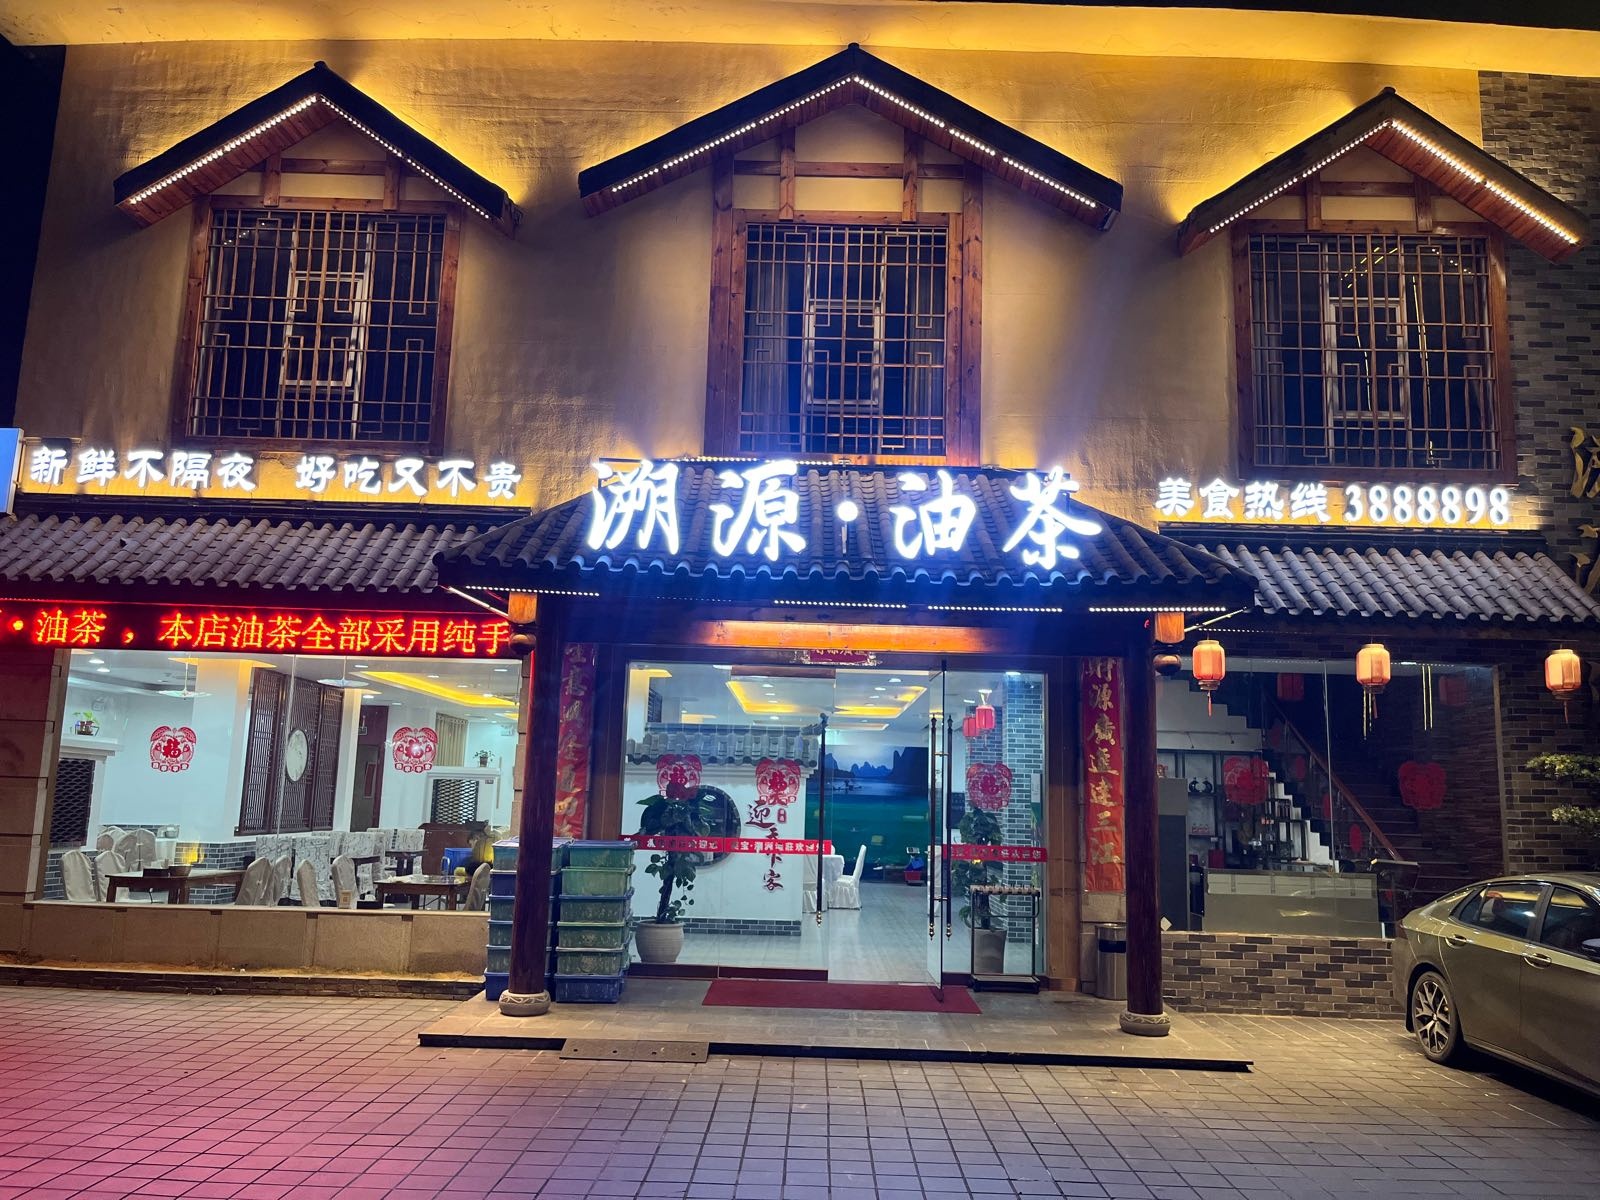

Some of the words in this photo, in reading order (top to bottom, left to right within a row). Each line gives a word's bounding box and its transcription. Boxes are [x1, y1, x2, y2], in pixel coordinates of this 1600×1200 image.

[30, 446, 257, 491] 新鲜不隔夜
[295, 455, 522, 499] 好吃又不贵
[587, 459, 1102, 570] 溯源·油茶
[1155, 477, 1331, 522] 美食热线
[1344, 484, 1511, 526] 3888898
